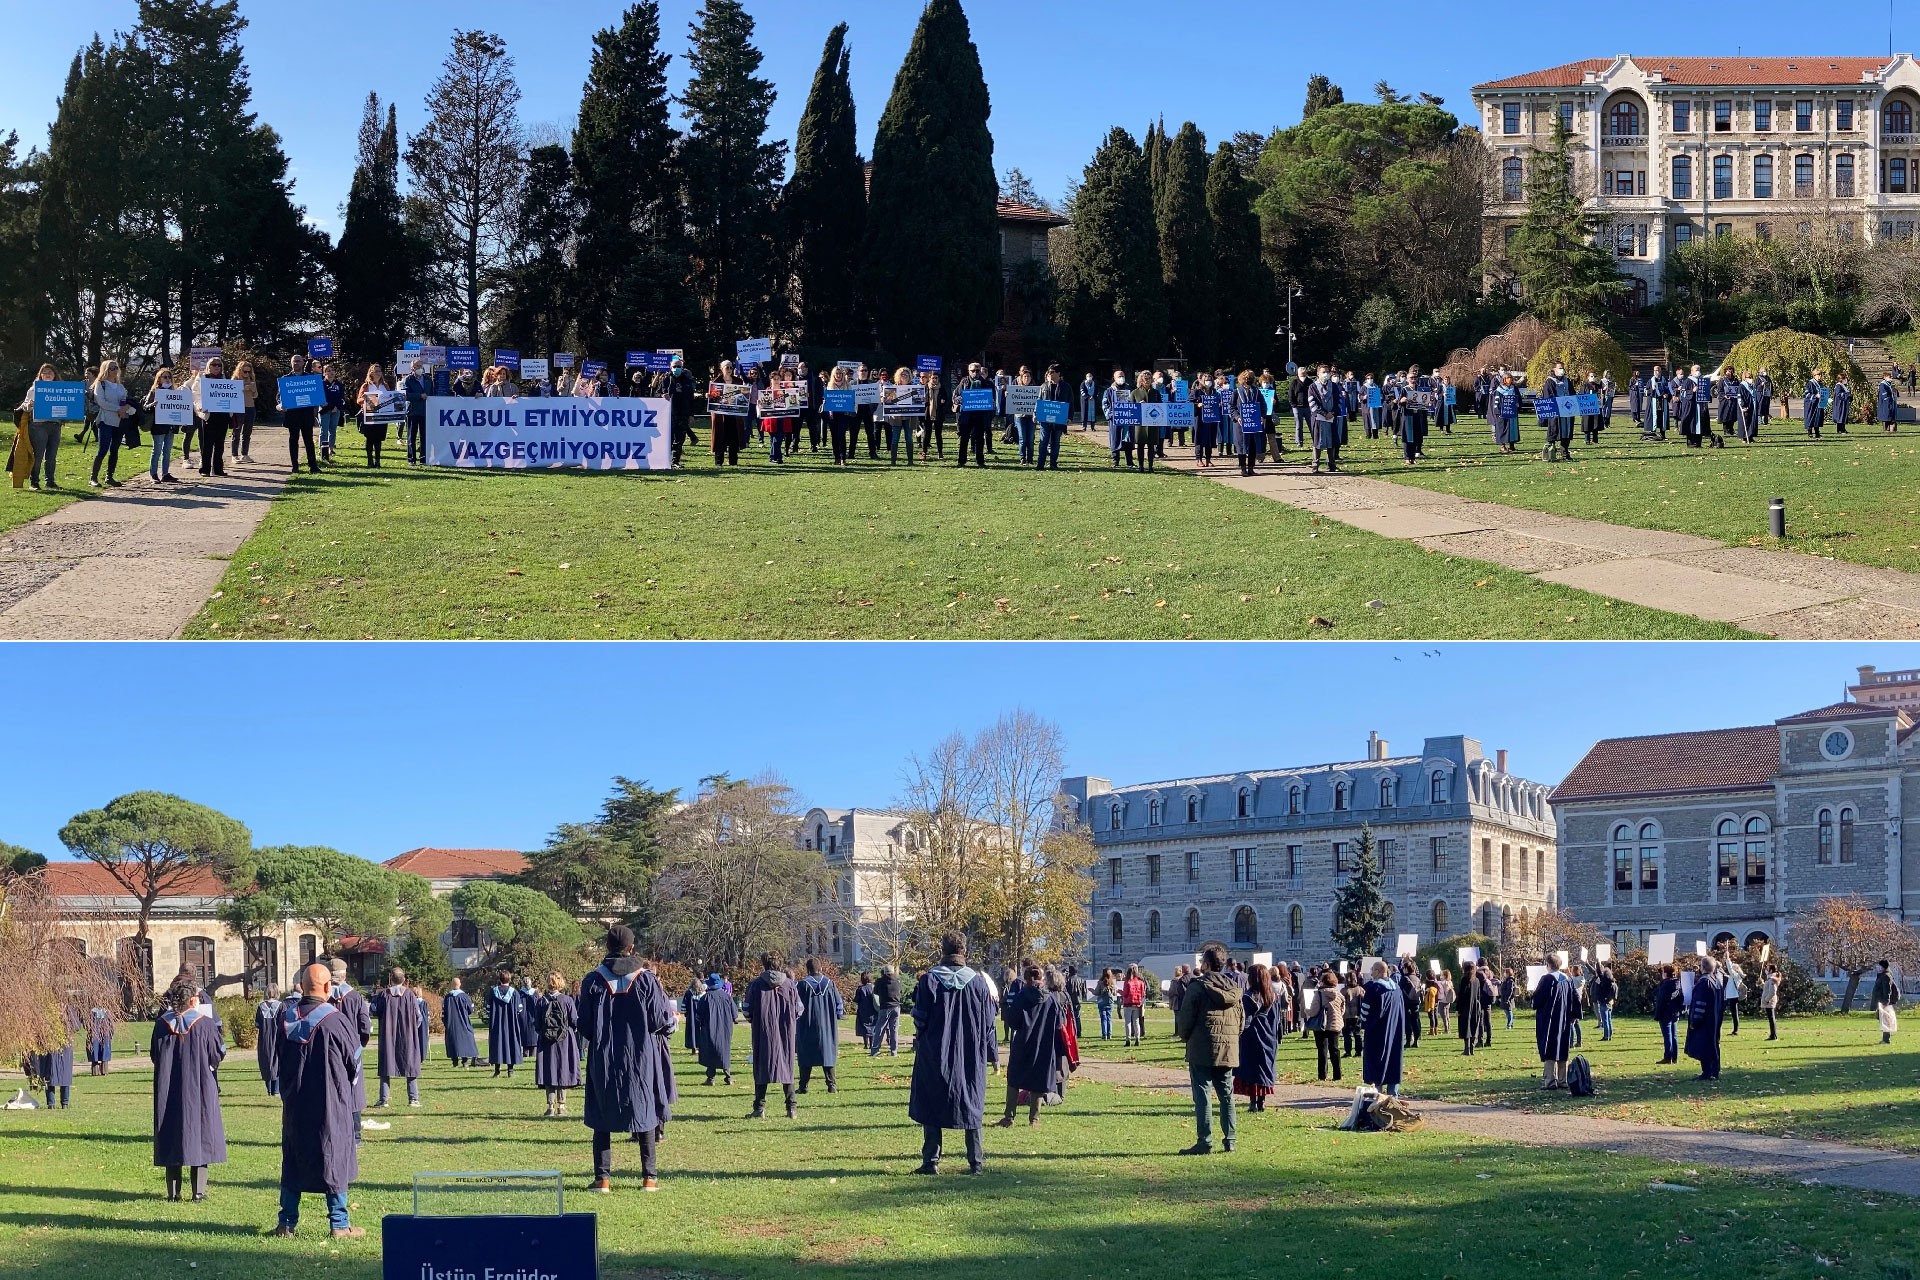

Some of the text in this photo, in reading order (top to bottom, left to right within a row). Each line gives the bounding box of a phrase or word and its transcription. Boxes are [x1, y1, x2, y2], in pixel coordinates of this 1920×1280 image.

[209, 391, 238, 399] MİYORUZ
[160, 402, 191, 411] ETMİYORUZ
[439, 405, 658, 428] KABUL ETMİYORUZ
[449, 437, 646, 464] VAZGEÇMİYORUZ
